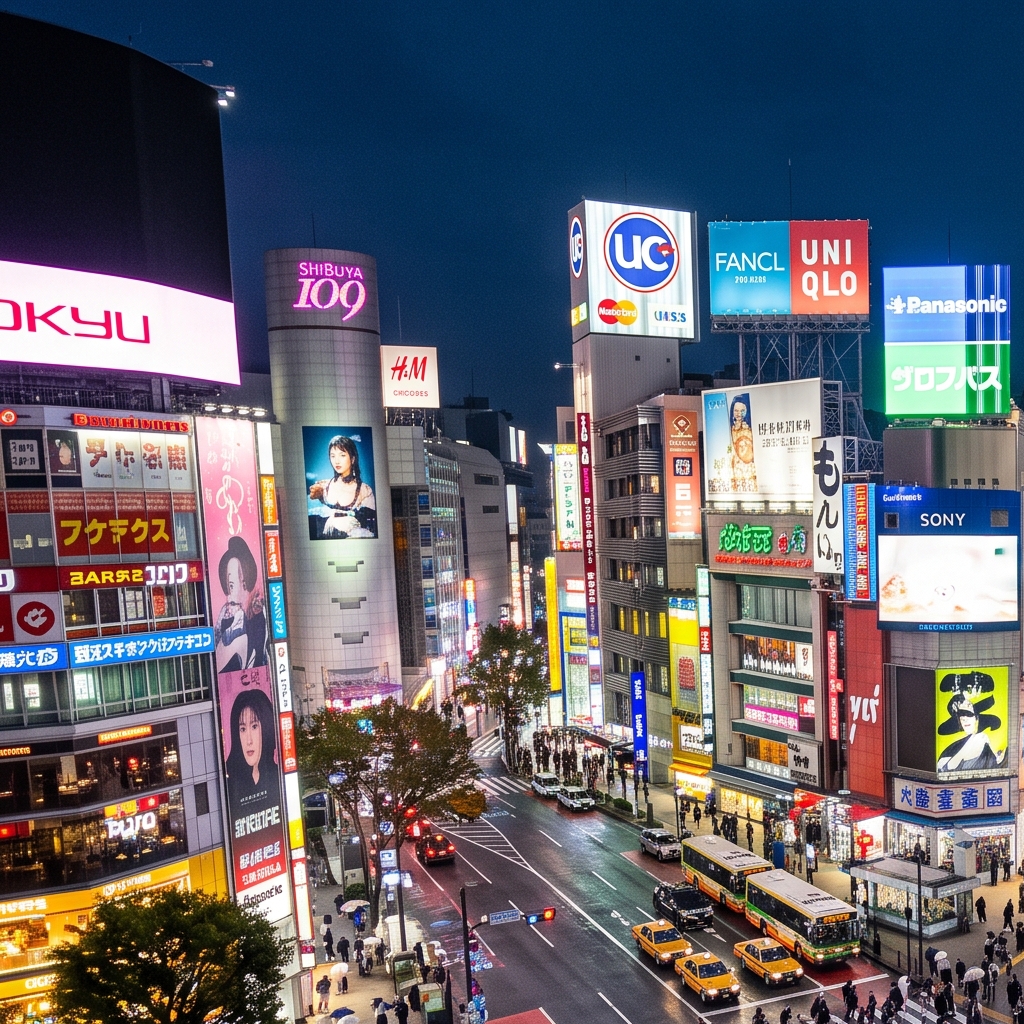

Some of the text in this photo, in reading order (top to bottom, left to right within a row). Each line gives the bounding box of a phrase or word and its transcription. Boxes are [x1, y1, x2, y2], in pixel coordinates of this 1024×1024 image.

[614, 233, 669, 272] UC
[715, 252, 785, 272] FANCL
[801, 239, 851, 265] UNI
[299, 262, 363, 279] SHIBUYA
[801, 270, 857, 301] QLO
[293, 278, 366, 322] 109
[906, 294, 1008, 314] Panasonic
[920, 513, 966, 527] SONY
